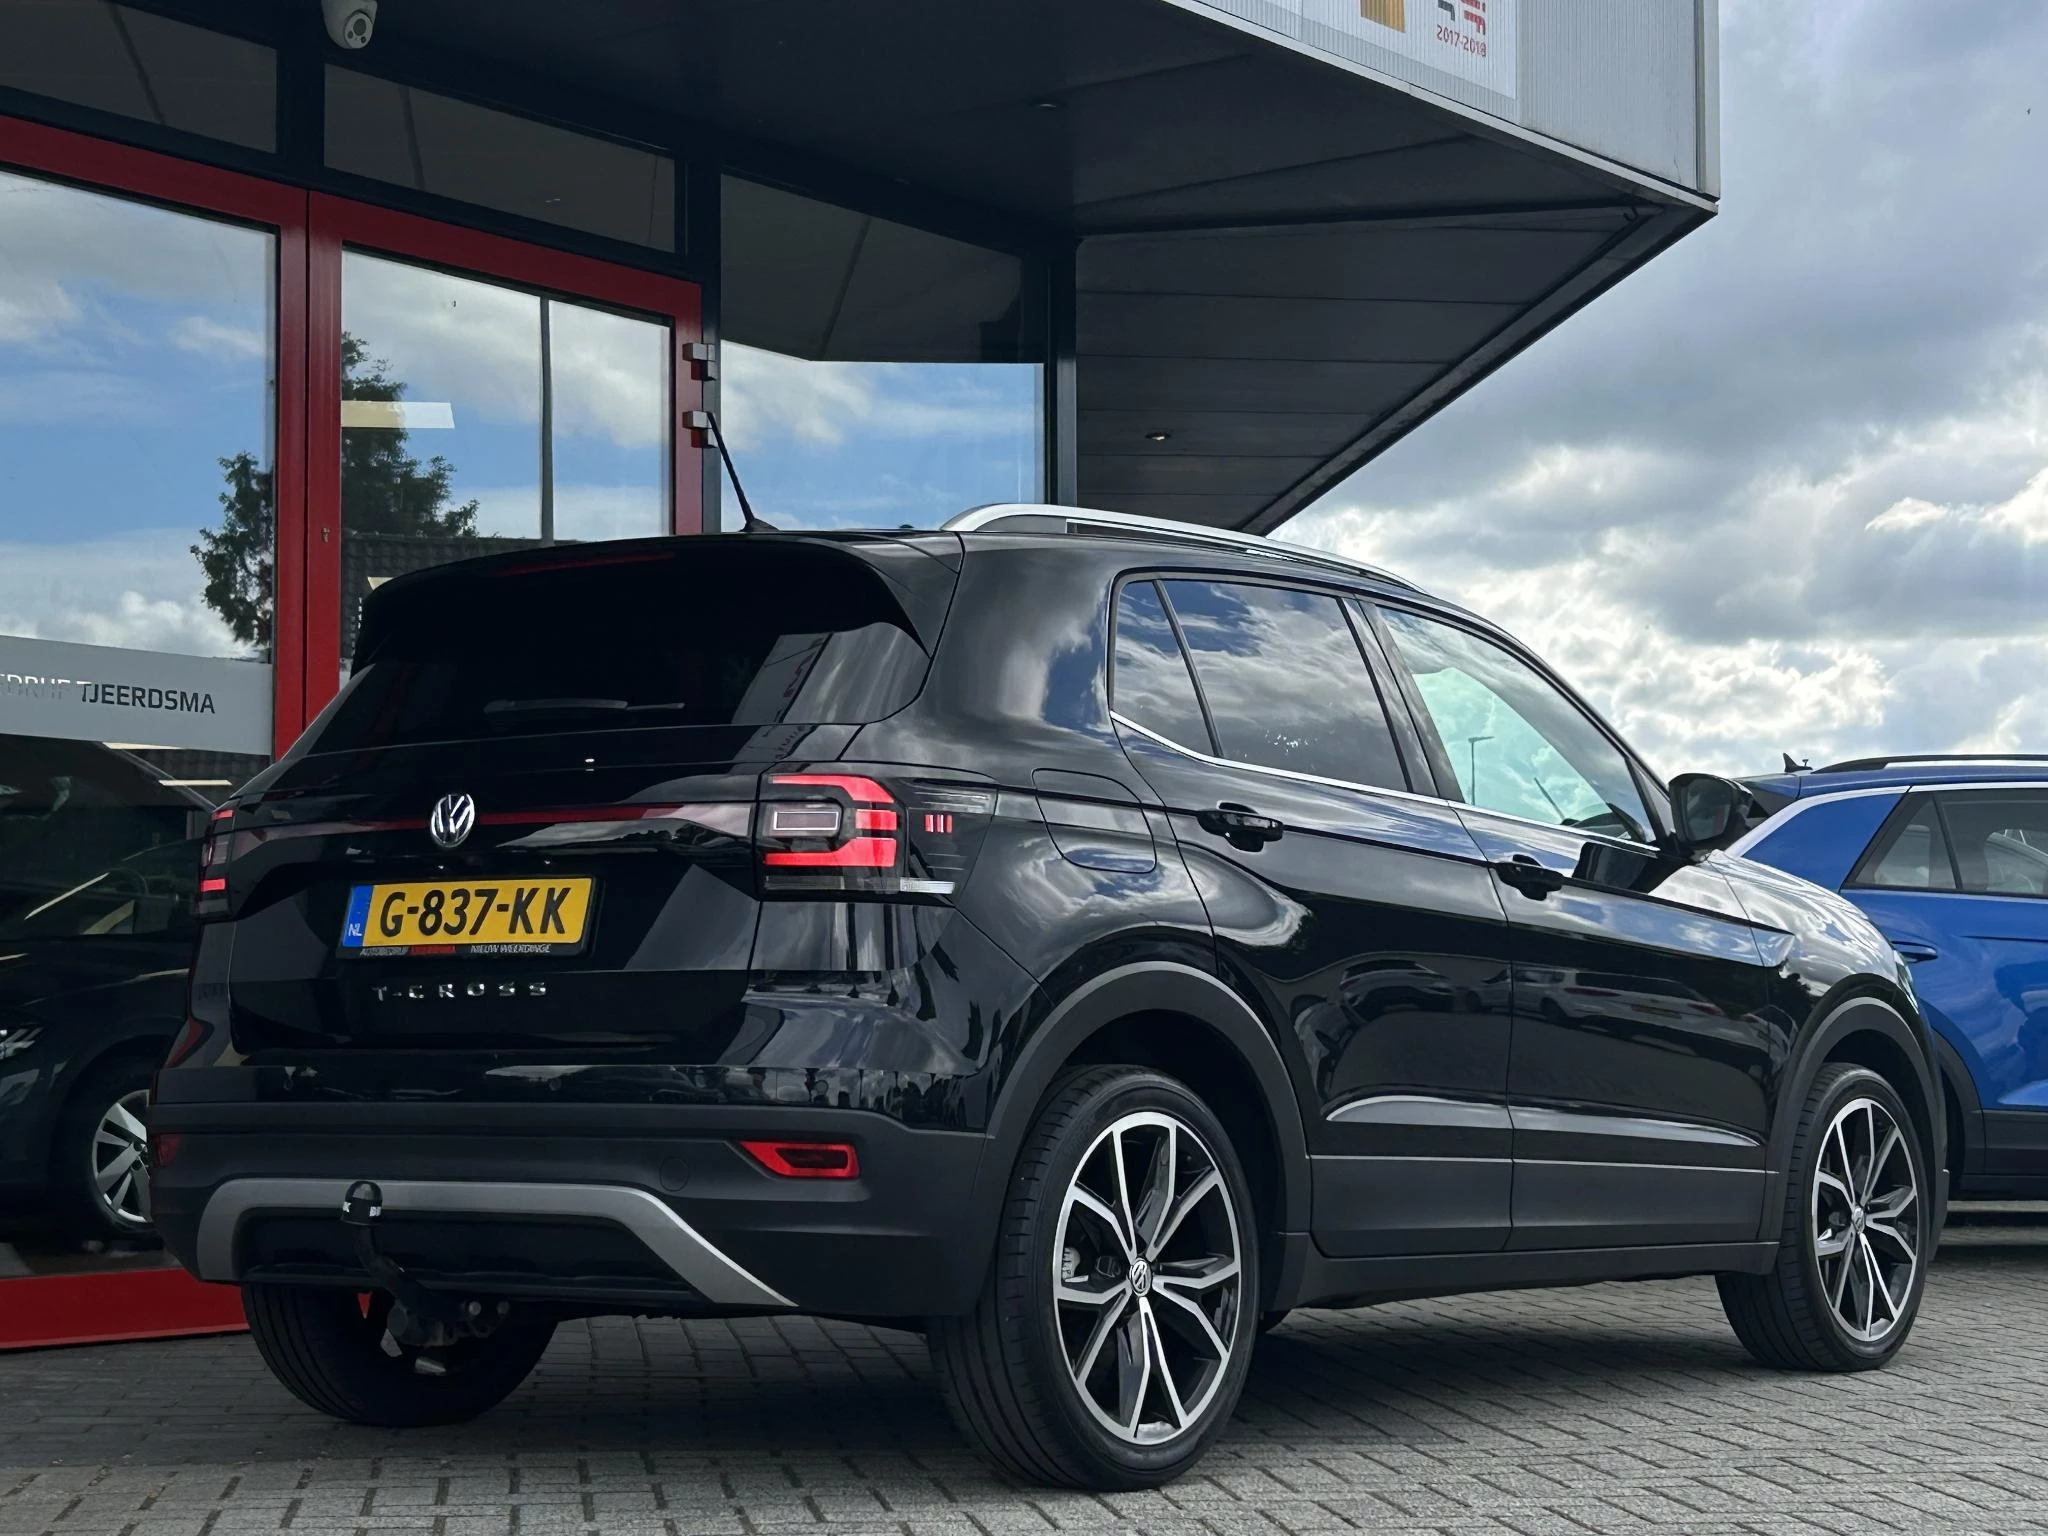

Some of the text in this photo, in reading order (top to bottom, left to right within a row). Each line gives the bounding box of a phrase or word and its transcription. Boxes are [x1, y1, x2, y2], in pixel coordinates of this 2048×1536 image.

[76, 680, 216, 714] TJEERDSMA
[379, 886, 571, 938] G-837-KK
[348, 922, 363, 937] NL
[371, 981, 547, 1002] T-CROSS
